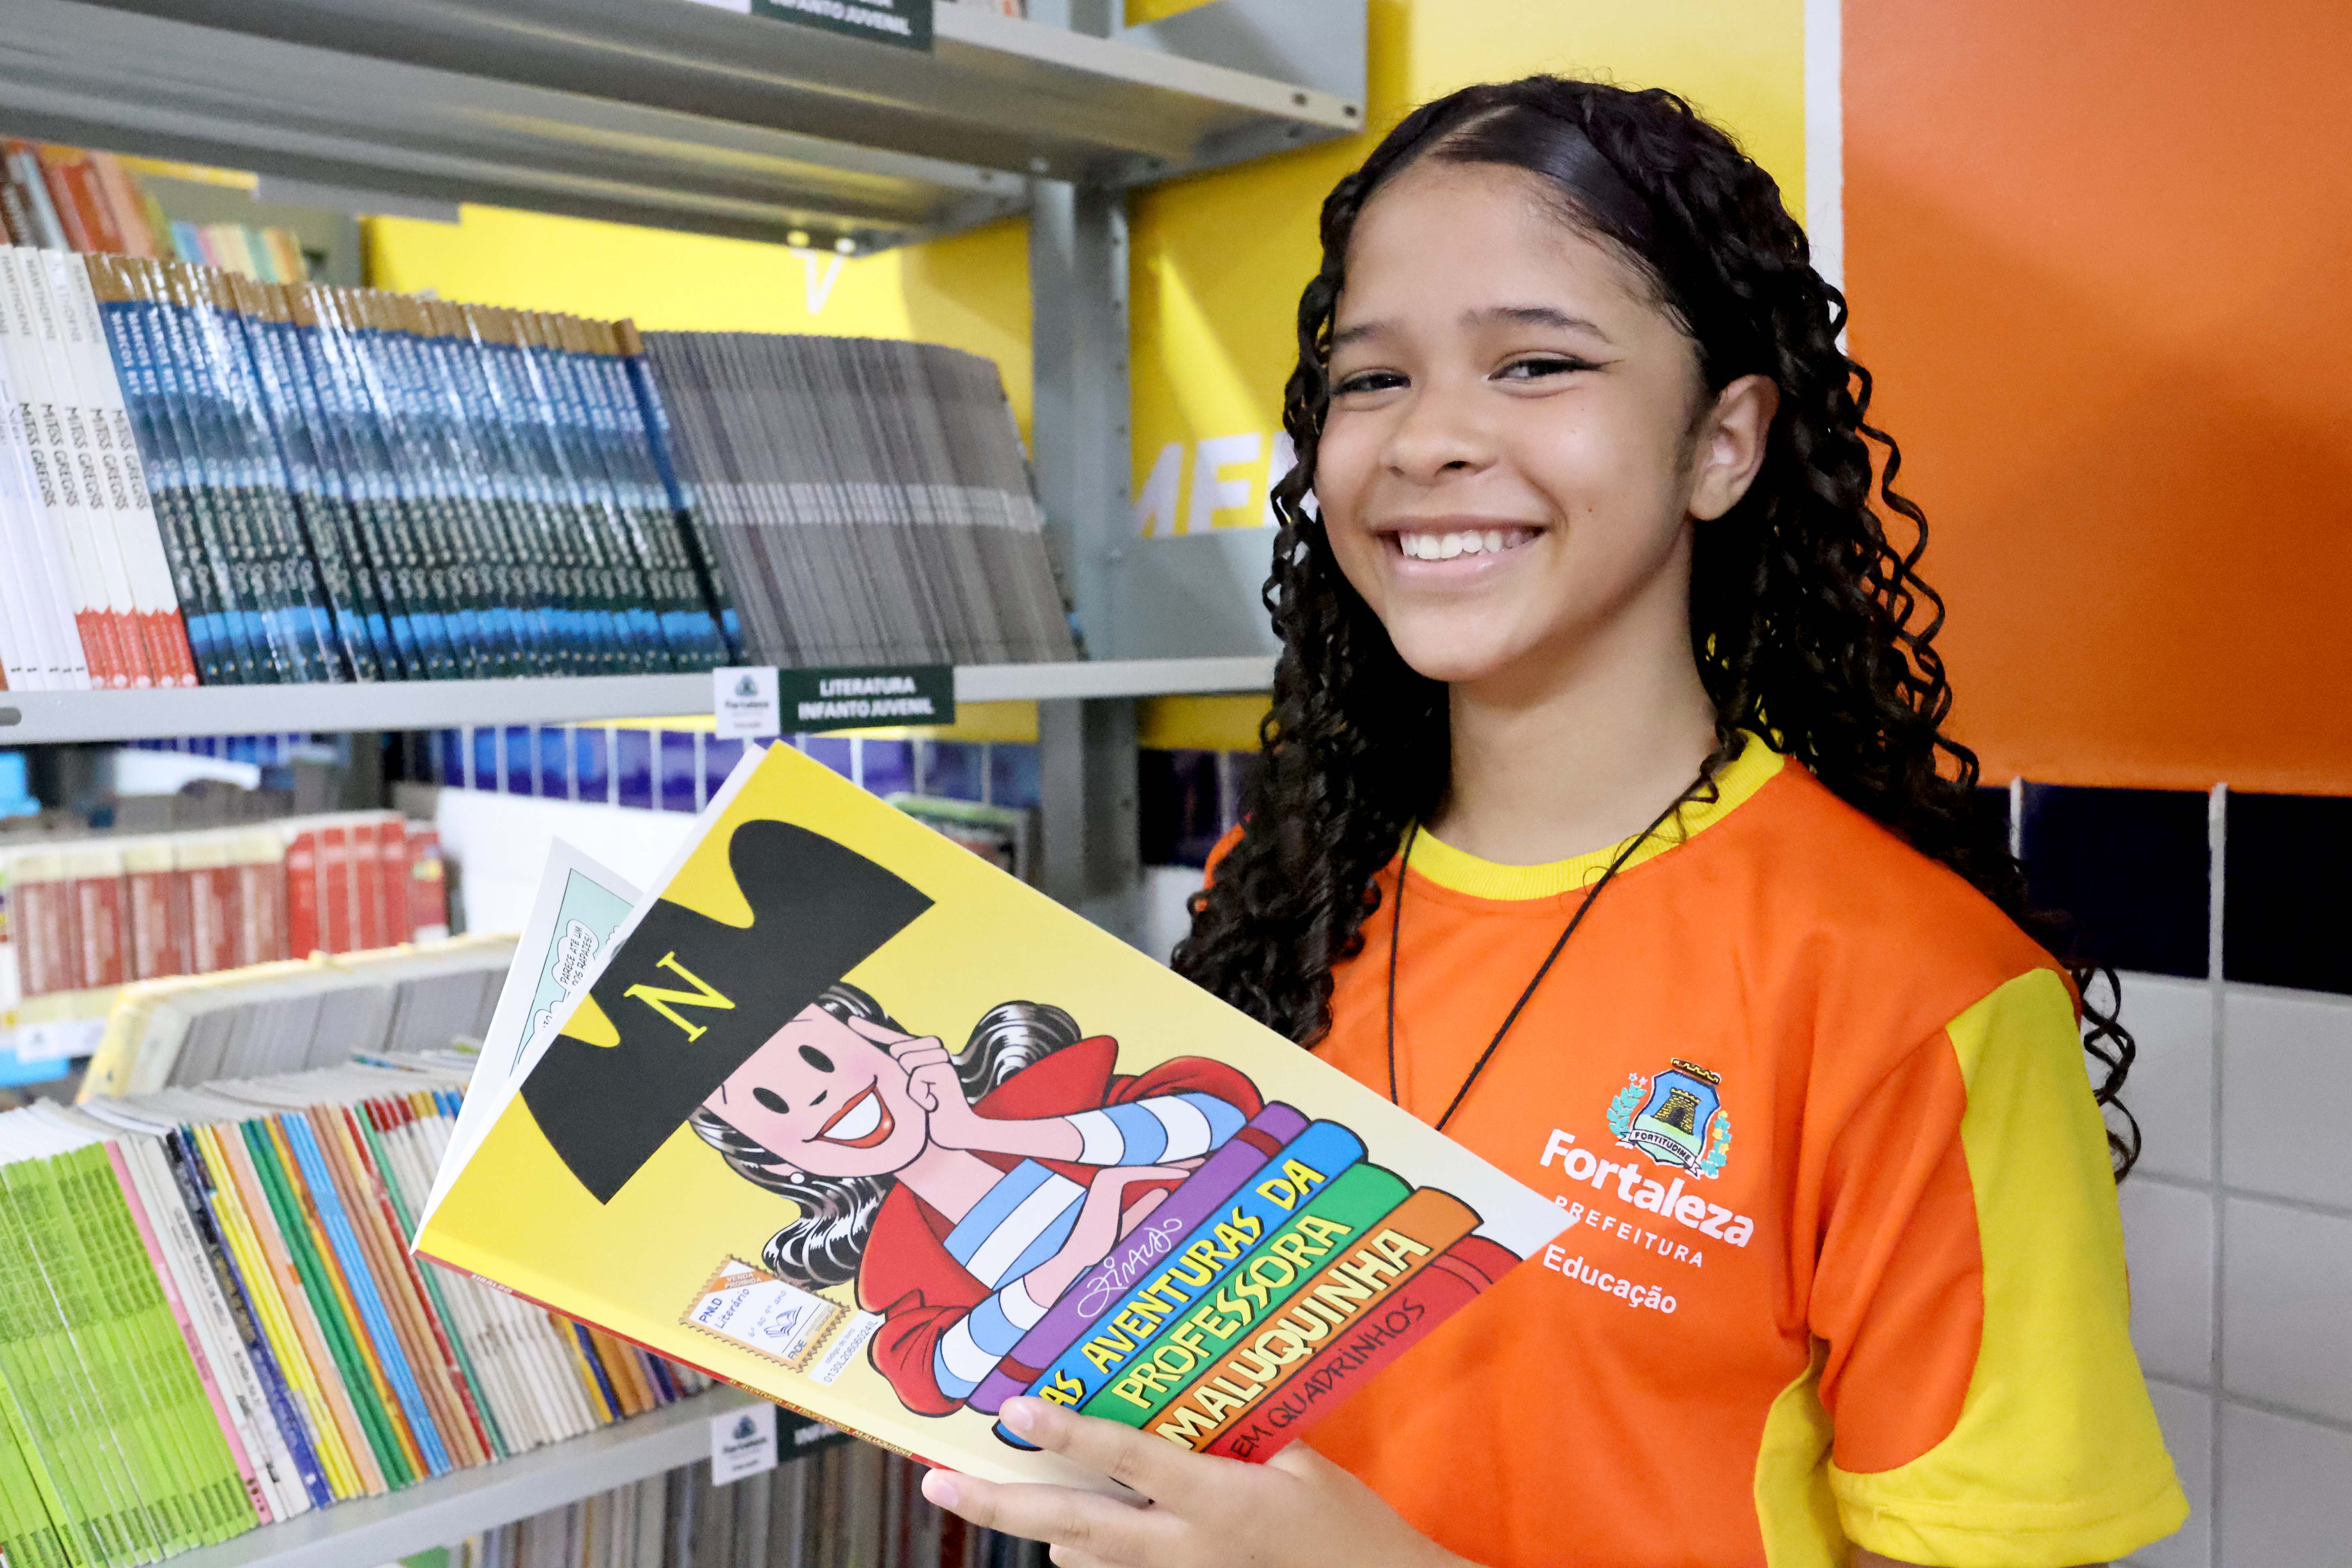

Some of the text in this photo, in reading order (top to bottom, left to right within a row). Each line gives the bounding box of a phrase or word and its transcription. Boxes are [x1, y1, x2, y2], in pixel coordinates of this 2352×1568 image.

[819, 676, 916, 697] LITERATURA
[798, 700, 866, 720] INFANTO
[560, 925, 583, 984] PARECE ATÉ UM
[577, 933, 593, 970] RAPAZES!
[623, 951, 736, 1042] N
[1634, 1131, 1692, 1162] FORTITUDINE
[1539, 1128, 1754, 1248] Fortaleza
[1554, 1195, 1702, 1268] PREFEITURA
[724, 1276, 763, 1289] PROIBIDA
[726, 1272, 754, 1283] VENDA
[1080, 1206, 1266, 1376] AVENTURAS
[1255, 1158, 1329, 1211] DA
[1542, 1244, 1677, 1314] Educação
[699, 1297, 723, 1323] PNLD
[714, 1288, 750, 1330] Literário
[1111, 1213, 1355, 1409] PROFESSORA
[787, 1339, 807, 1361] FNDE
[1155, 1227, 1434, 1450] MALUQUINHA
[1230, 1424, 1274, 1457] EM
